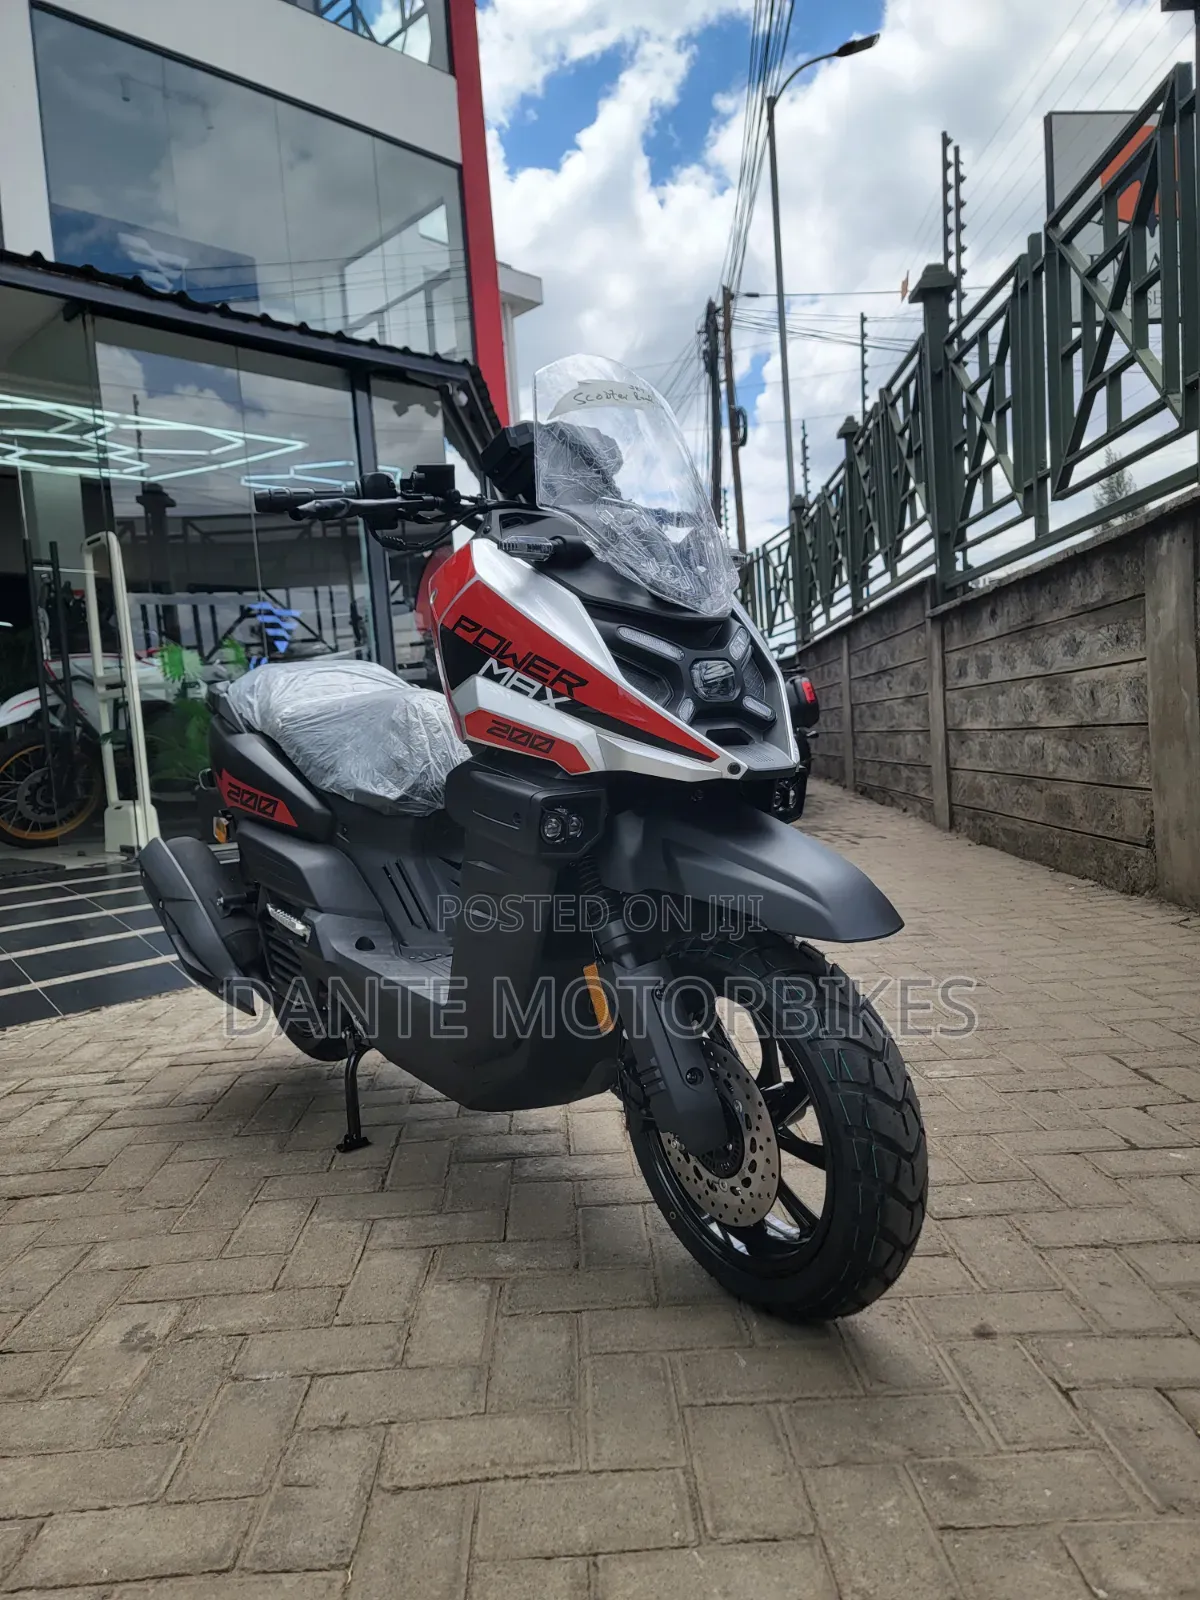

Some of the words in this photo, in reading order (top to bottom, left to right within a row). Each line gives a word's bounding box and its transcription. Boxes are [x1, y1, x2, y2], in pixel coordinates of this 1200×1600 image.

[573, 389, 628, 405] Scooter
[451, 615, 589, 698] POWER
[477, 657, 573, 710] MAX
[486, 719, 556, 754] 200
[226, 782, 279, 818] 200
